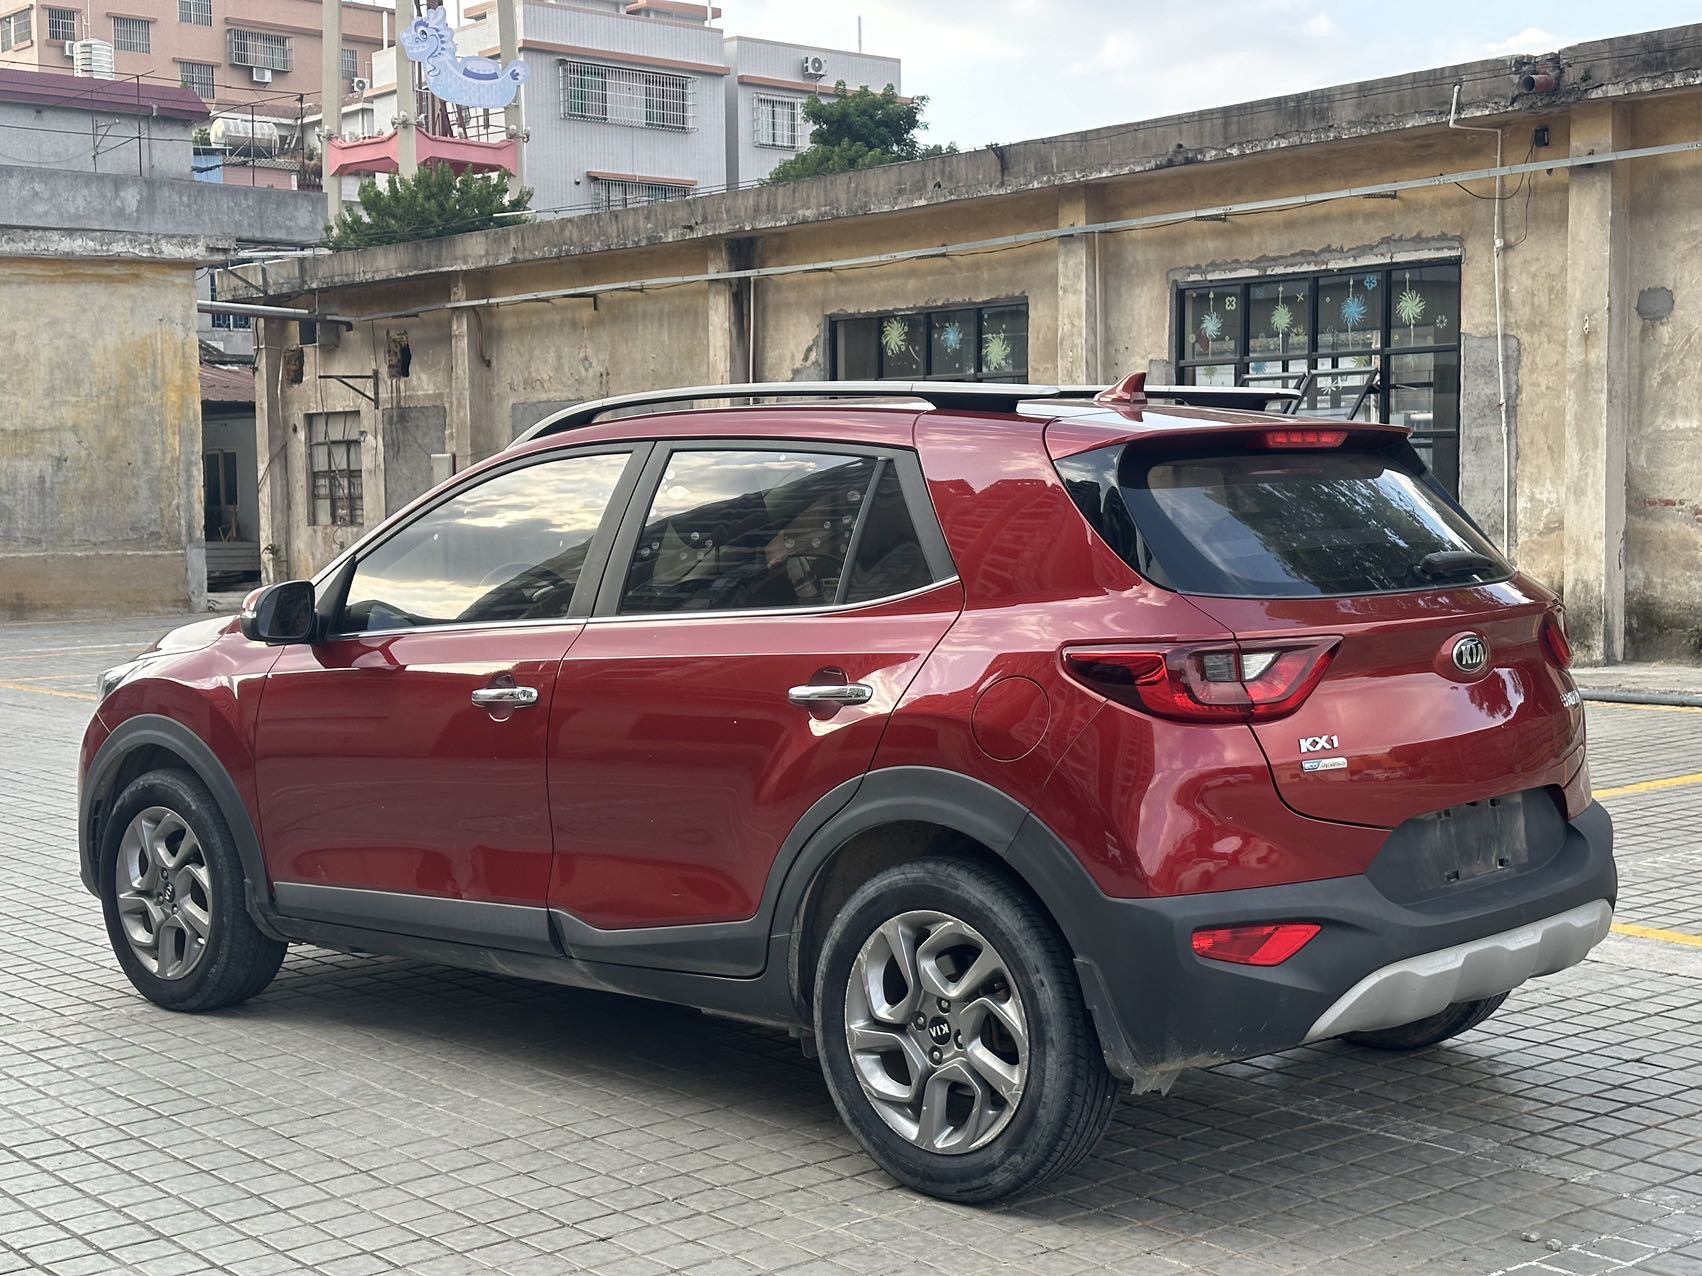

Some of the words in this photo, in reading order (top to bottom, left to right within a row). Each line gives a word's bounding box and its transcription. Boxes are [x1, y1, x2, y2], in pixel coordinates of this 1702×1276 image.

[1461, 643, 1485, 664] KIA
[1298, 734, 1339, 754] KX1
[929, 1023, 950, 1037] KIA
